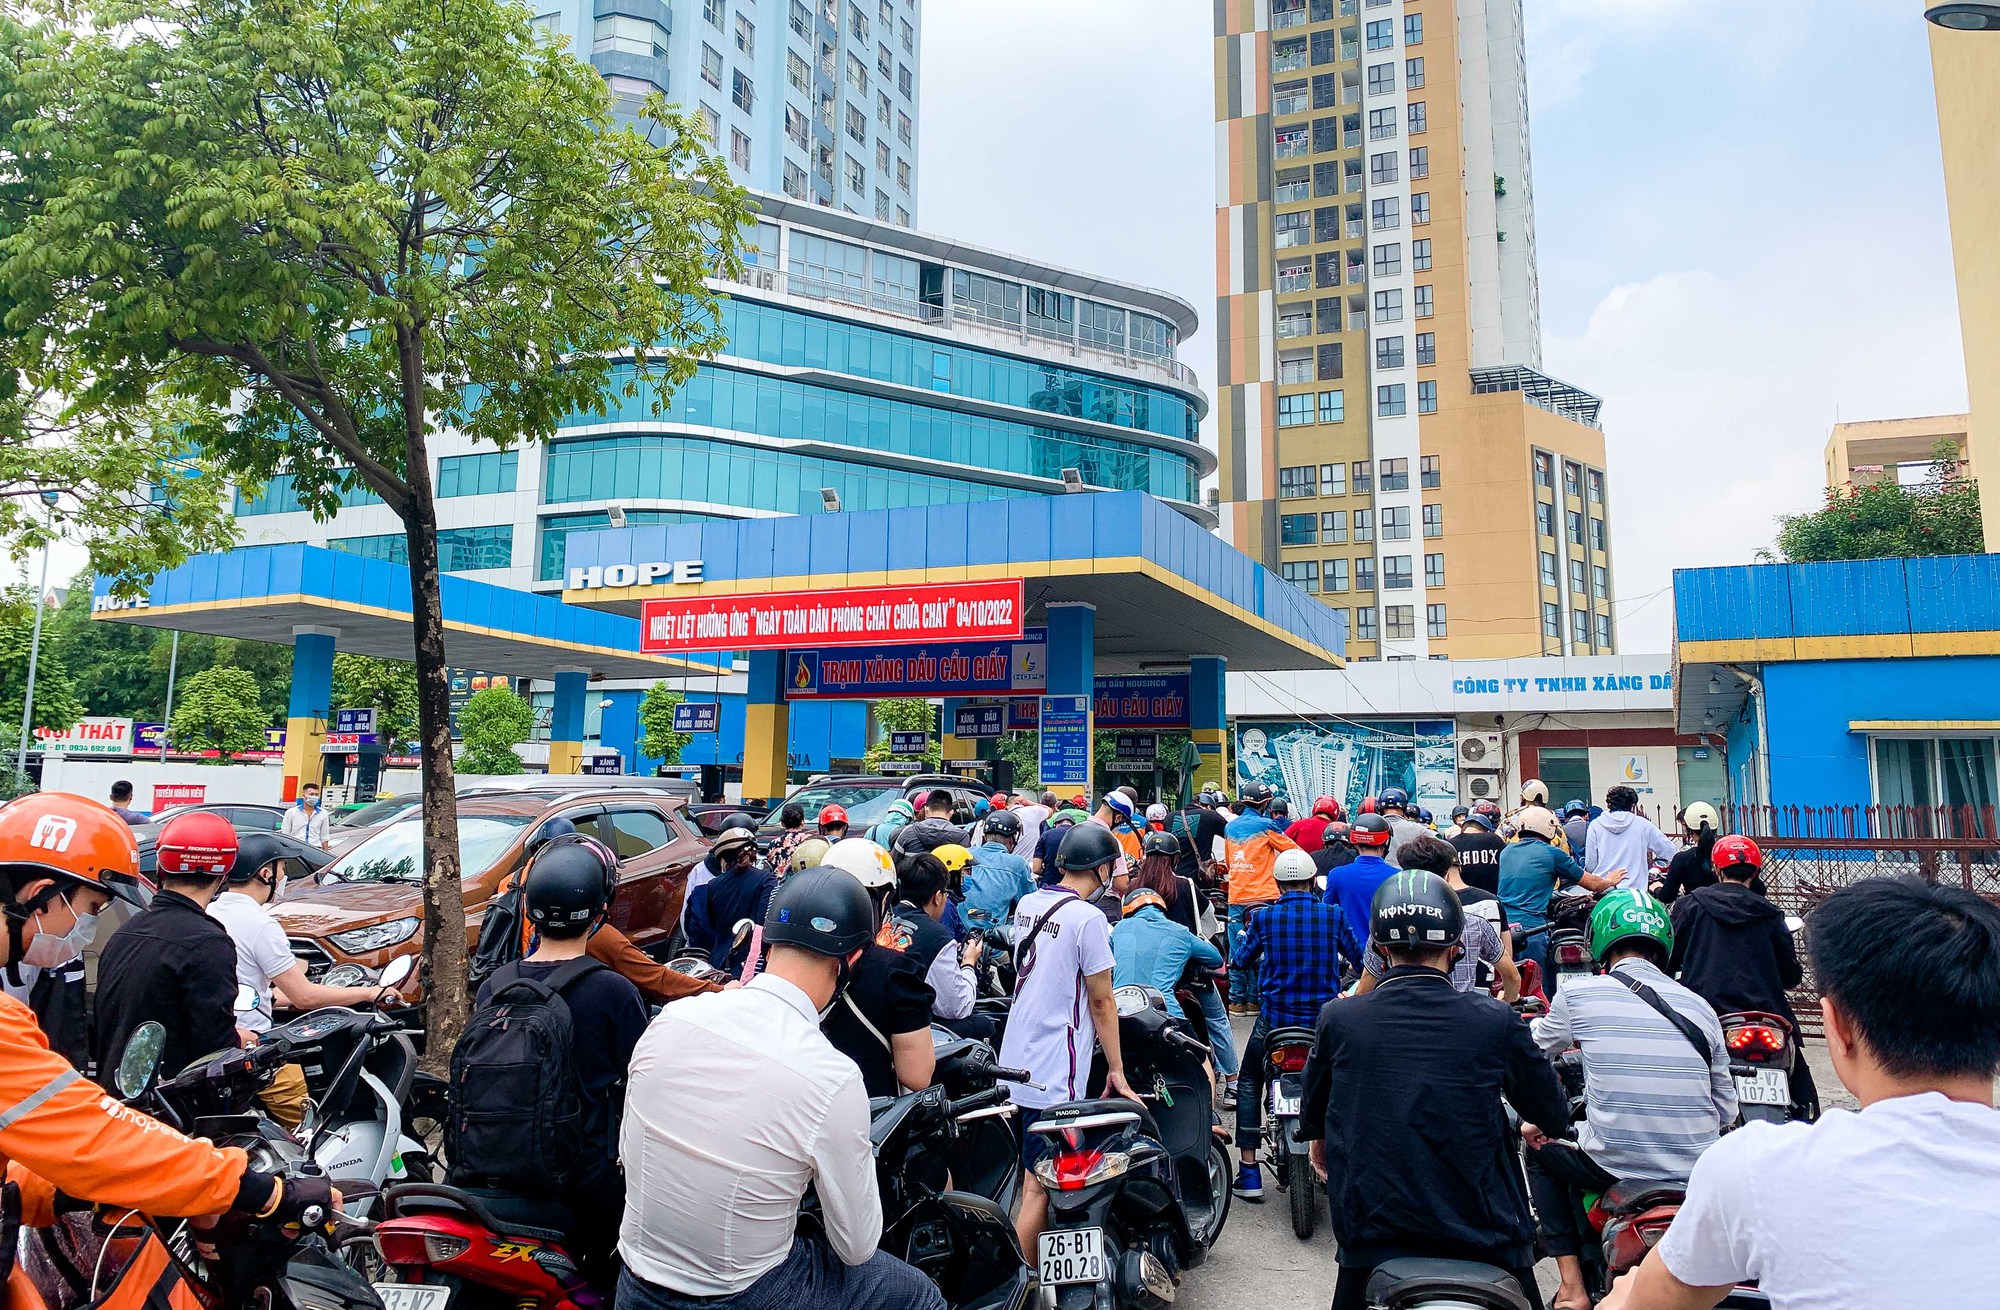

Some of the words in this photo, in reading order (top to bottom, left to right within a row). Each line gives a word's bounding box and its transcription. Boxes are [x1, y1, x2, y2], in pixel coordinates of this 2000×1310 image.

[569, 560, 704, 589] HOPE
[650, 611, 676, 645] NHIỆT
[677, 610, 696, 645] LIỆT
[697, 603, 728, 639] HƯỞNG
[729, 605, 749, 637] ỨNG
[783, 604, 807, 635] TOÀN
[809, 603, 829, 633] DÂN
[831, 601, 864, 633] PHÒNG
[866, 600, 891, 631] CHÁY
[893, 598, 920, 629] CHỮA
[956, 599, 1013, 627] 04/10/2022
[822, 660, 862, 689] TRẠM
[865, 655, 903, 684] XĂNG
[906, 650, 937, 683] DẦU
[939, 649, 969, 682] CẦU
[972, 647, 1008, 682] GIẤY
[1452, 676, 1499, 694] CÔNG
[1504, 678, 1529, 693] TY
[1535, 677, 1587, 692] TNHH
[1593, 673, 1643, 692] XĂNG
[79, 719, 125, 740] THẤT
[1379, 903, 1443, 919] MONSTER
[1622, 908, 1665, 929] Grab
[1035, 914, 1061, 939] Hang
[1742, 1086, 1786, 1103] 107.31
[328, 1158, 363, 1171] HONDA
[489, 1243, 540, 1263] ZX
[534, 1251, 567, 1263] Wave
[1047, 1232, 1091, 1257] 26-B1
[1043, 1255, 1100, 1283] 280.28
